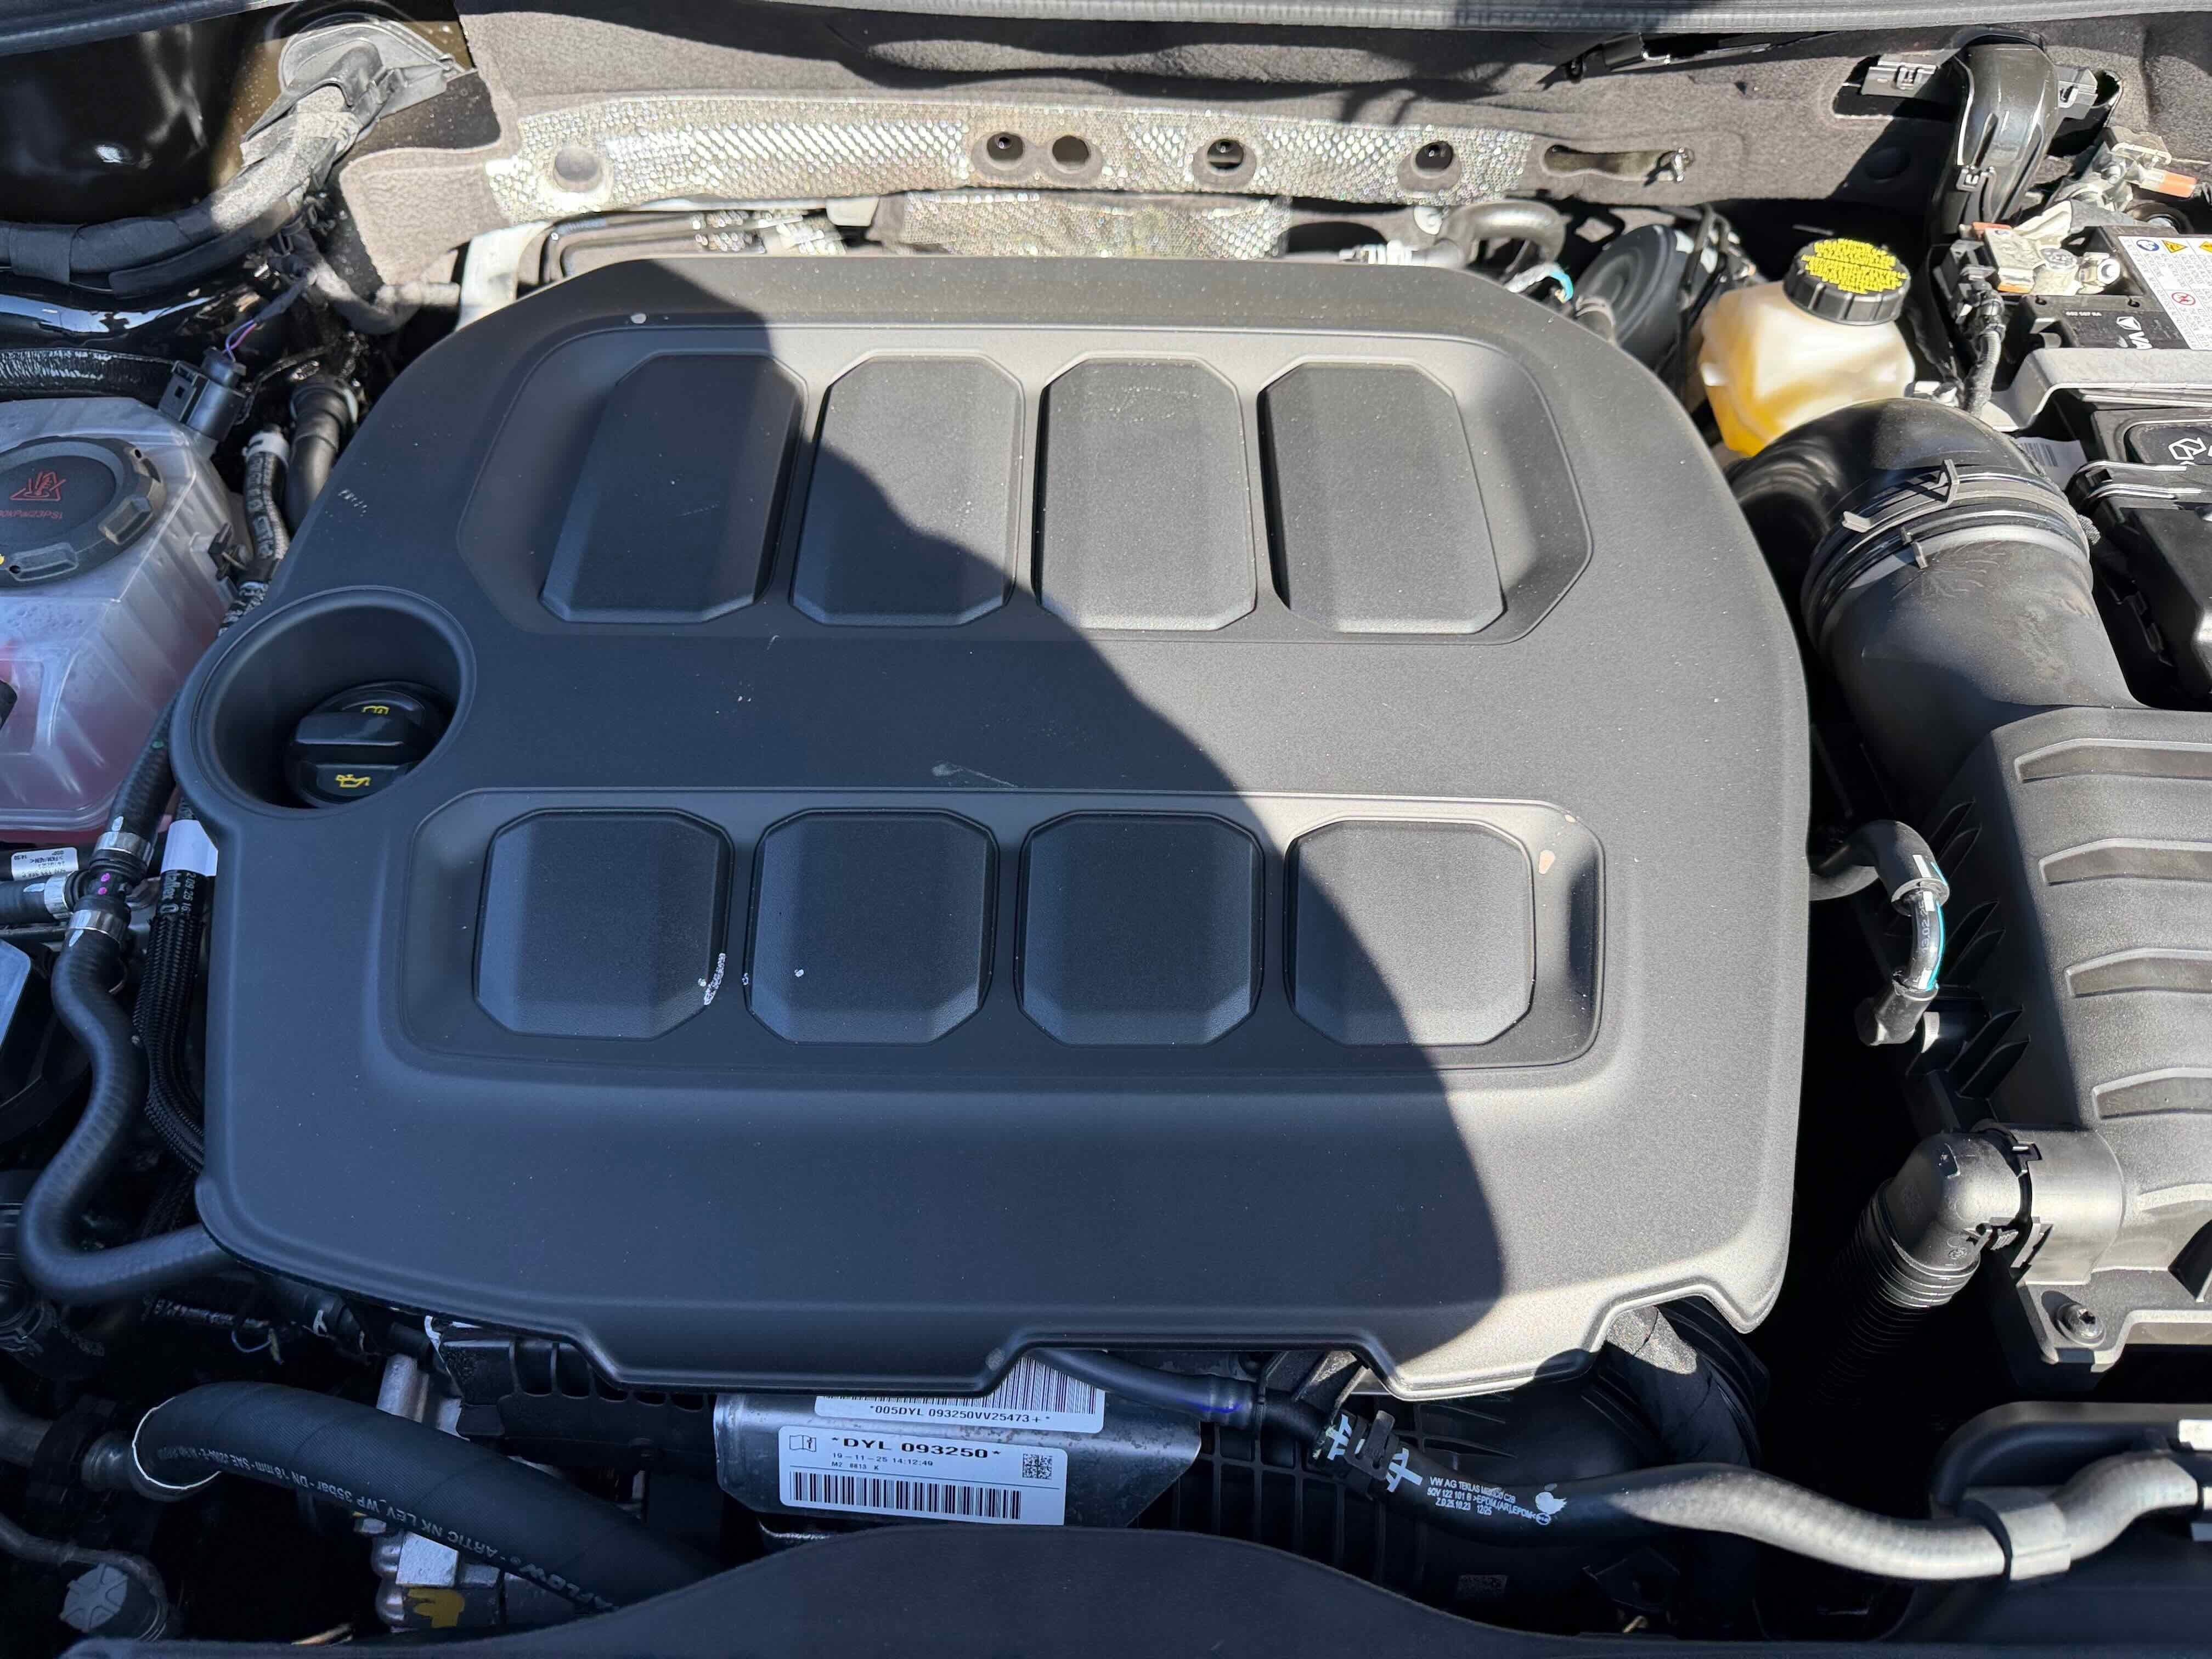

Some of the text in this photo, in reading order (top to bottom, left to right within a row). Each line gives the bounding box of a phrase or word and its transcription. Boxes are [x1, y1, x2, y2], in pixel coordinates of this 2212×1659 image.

[893, 1458, 933, 1466] 14:12:49
[318, 1480, 353, 1503] 35bar
[1430, 1476, 1443, 1486] VW
[1444, 1479, 1457, 1488] AG
[1458, 1481, 1480, 1493] TEKLAS
[1442, 1489, 1453, 1498] 122
[1454, 1491, 1465, 1500] 101
[421, 1518, 443, 1536] NK
[448, 1531, 499, 1558] ARTIC
